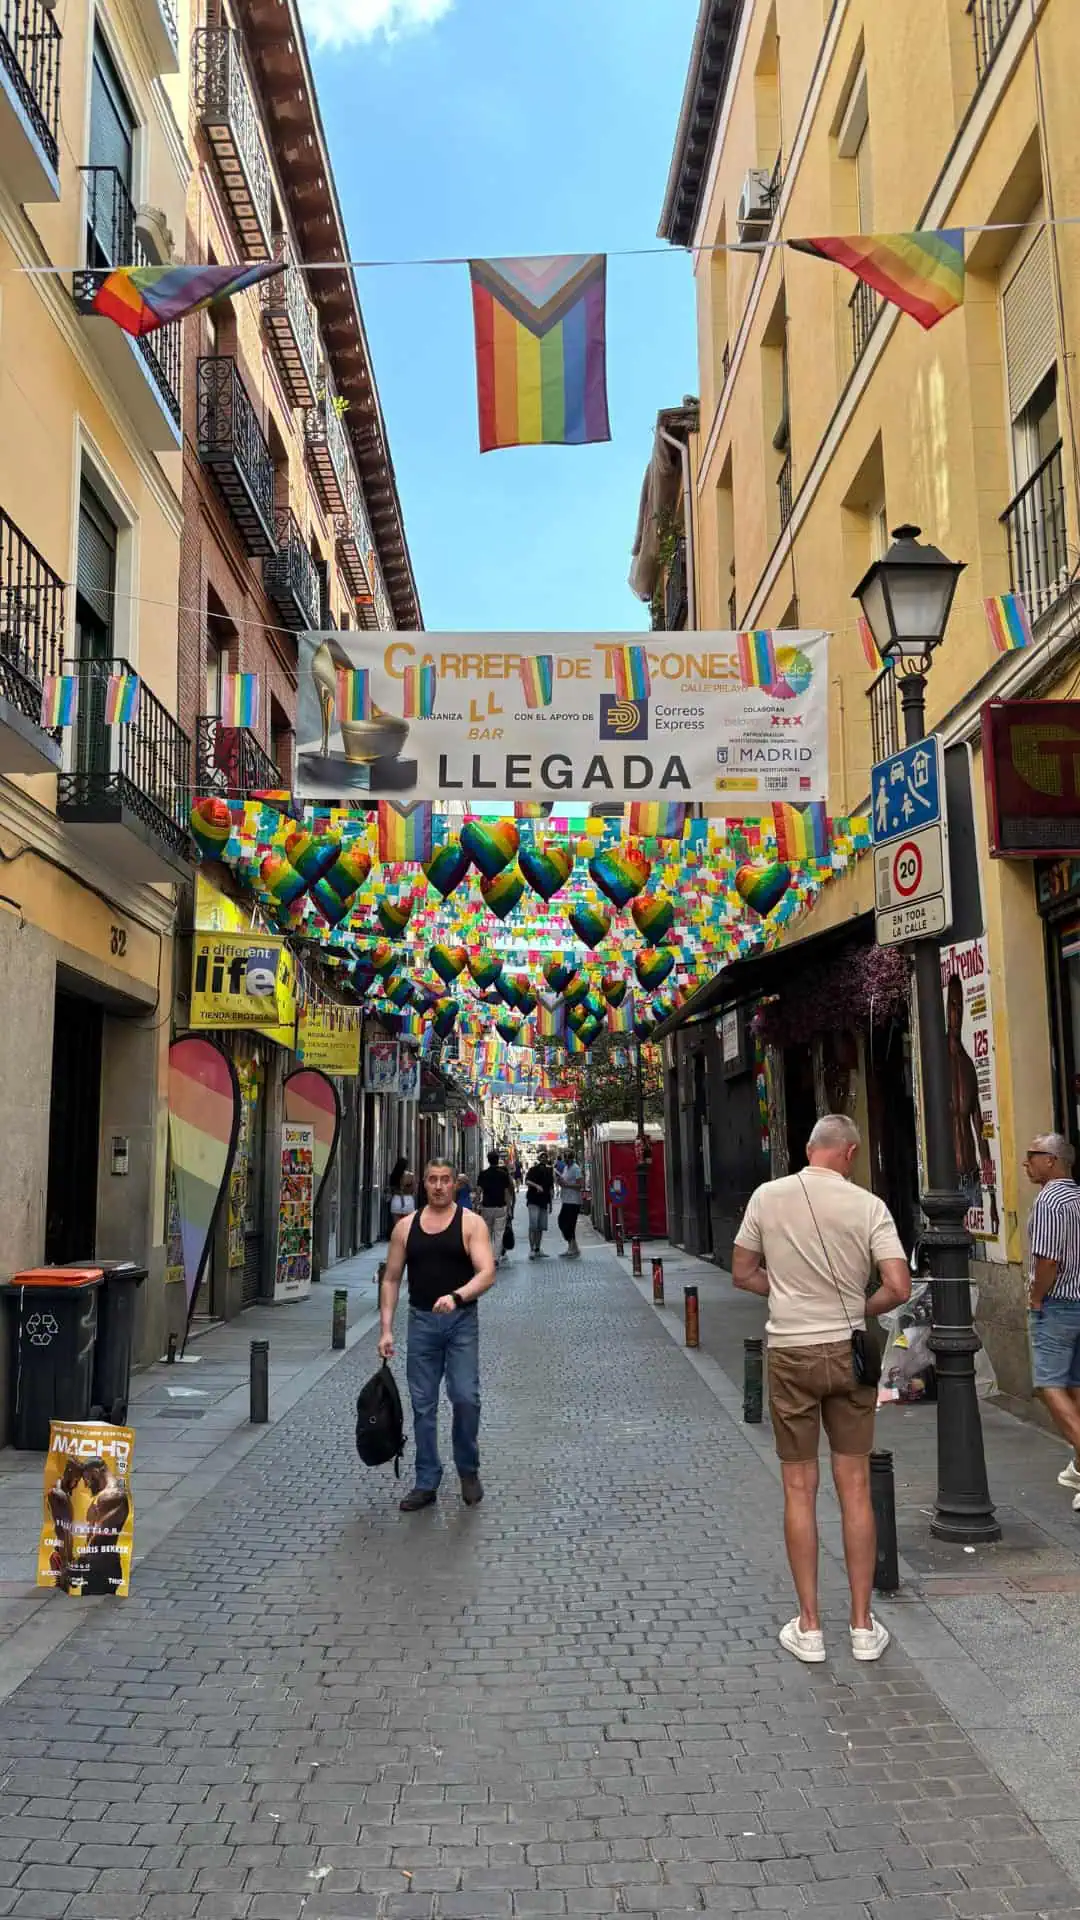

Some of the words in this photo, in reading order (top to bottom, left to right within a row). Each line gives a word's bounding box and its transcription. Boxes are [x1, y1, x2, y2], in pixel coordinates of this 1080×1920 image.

[556, 657, 592, 680] DE
[514, 713, 533, 721] CON
[536, 713, 547, 721] EL
[550, 713, 580, 721] APOYO
[582, 713, 594, 721] DE
[655, 704, 705, 717] Correos
[468, 727, 504, 741] BAR
[655, 718, 705, 731] Express
[740, 748, 812, 761] MADRID
[438, 754, 691, 791] LLEGADA
[900, 859, 916, 879] 20
[892, 913, 903, 926] EN
[905, 907, 927, 921] TODA
[892, 927, 902, 938] LA
[904, 919, 928, 935] CALLE
[110, 925, 127, 957] 32
[201, 945, 210, 955] a
[195, 955, 276, 996] life
[973, 1029, 989, 1058] 125
